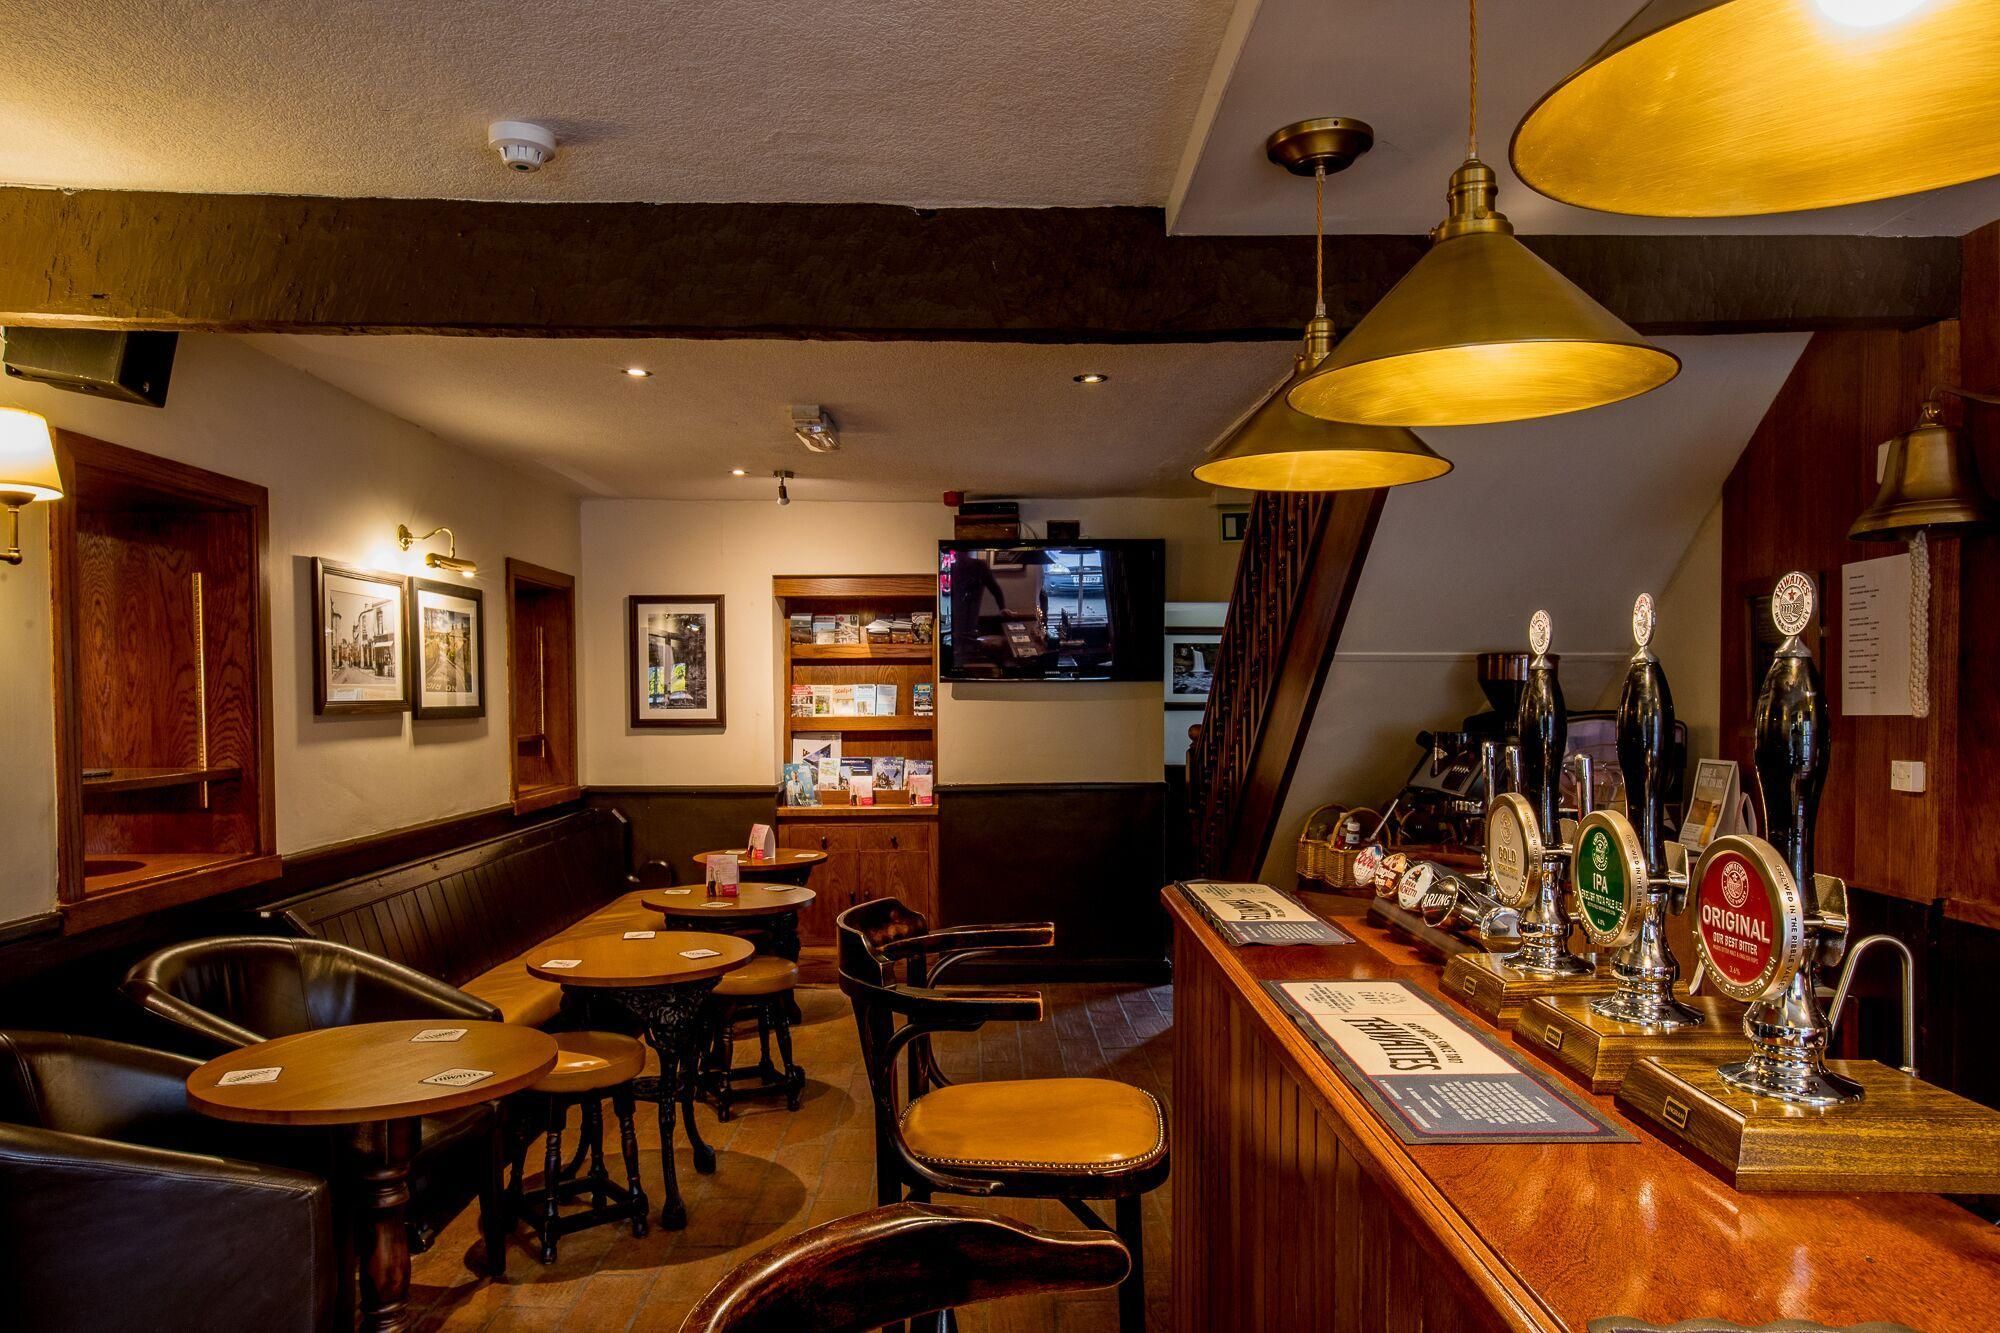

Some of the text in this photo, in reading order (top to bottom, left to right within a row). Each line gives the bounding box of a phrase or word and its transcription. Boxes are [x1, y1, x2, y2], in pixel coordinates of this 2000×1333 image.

[1775, 574, 1810, 599] THWAITES
[1498, 846, 1517, 864] GOLD
[1593, 872, 1608, 894] IPA
[1775, 864, 1794, 903] BREWED
[1422, 893, 1452, 907] ARLING
[1789, 905, 1796, 914] IN
[1702, 904, 1771, 944] ORIGINAL
[1790, 917, 1798, 933] THE
[1712, 931, 1758, 956] OUR BEST BITTER
[1788, 935, 1798, 963] RIBBLE
[1340, 1017, 1442, 1071] THWAITES
